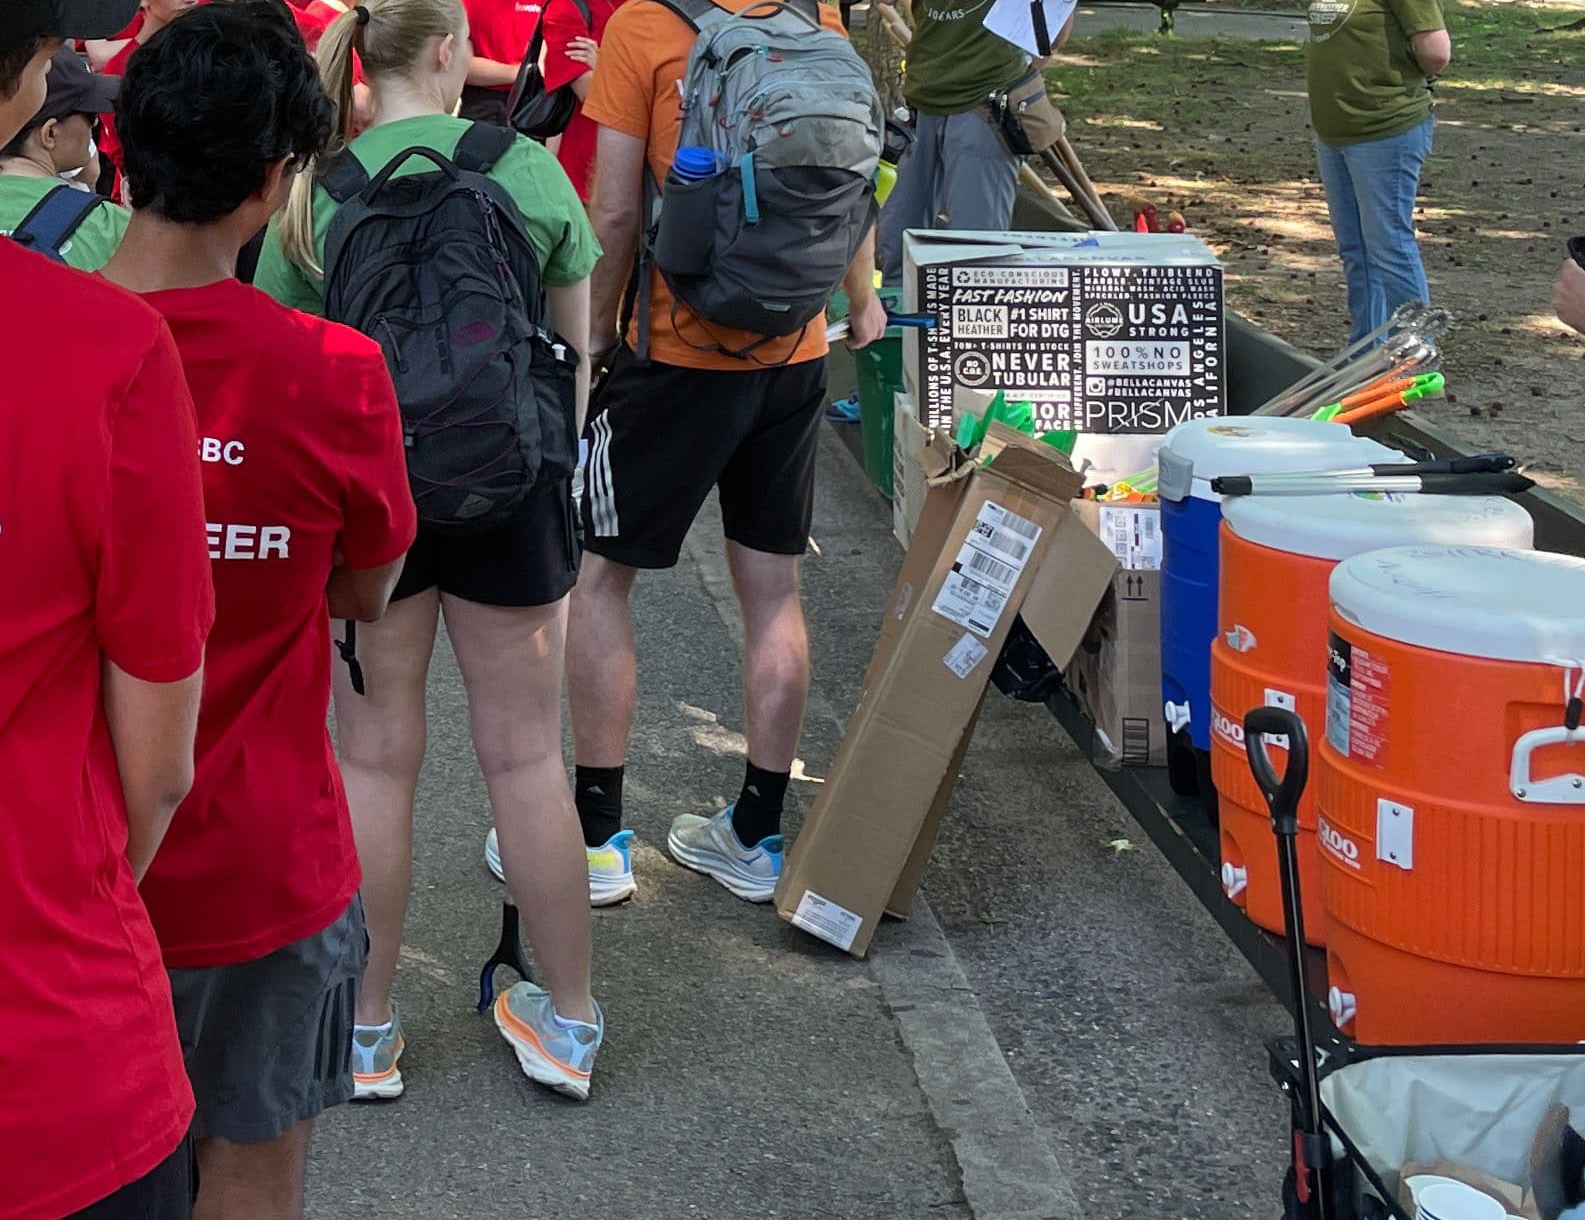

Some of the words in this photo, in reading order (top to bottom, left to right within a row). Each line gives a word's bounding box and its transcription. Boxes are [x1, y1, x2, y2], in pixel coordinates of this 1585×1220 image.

[1142, 268, 1213, 277] TRIBLEND
[926, 268, 937, 300] MADE
[938, 268, 950, 299] YEAR
[952, 289, 995, 304] FAST
[994, 290, 1068, 305] FASHION
[957, 308, 1003, 322] BLACK
[1011, 308, 1026, 321] #1
[1029, 308, 1069, 321] SHIRT
[1129, 303, 1189, 325] USA
[957, 324, 1004, 335] HEATHER
[1010, 323, 1038, 338] FOR
[1041, 323, 1069, 338] DTG
[1072, 323, 1082, 340] THE
[1128, 327, 1190, 337] STRONG
[1026, 342, 1037, 350] IN
[1040, 342, 1070, 350] STOCK
[1192, 301, 1204, 386] ANGELES
[1153, 346, 1181, 359] NO
[1205, 302, 1218, 418] ALIFORNIA
[928, 357, 939, 372] OF
[992, 352, 1071, 371] NEVER
[1093, 361, 1184, 371] SWEATSHOPS
[993, 371, 1071, 387] TUBULAR
[928, 375, 939, 428] MILLIONS
[940, 388, 952, 411] THE
[1086, 400, 1192, 429] PRISM
[1194, 399, 1205, 420] OS
[940, 415, 953, 429] IN
[197, 436, 245, 466] BC
